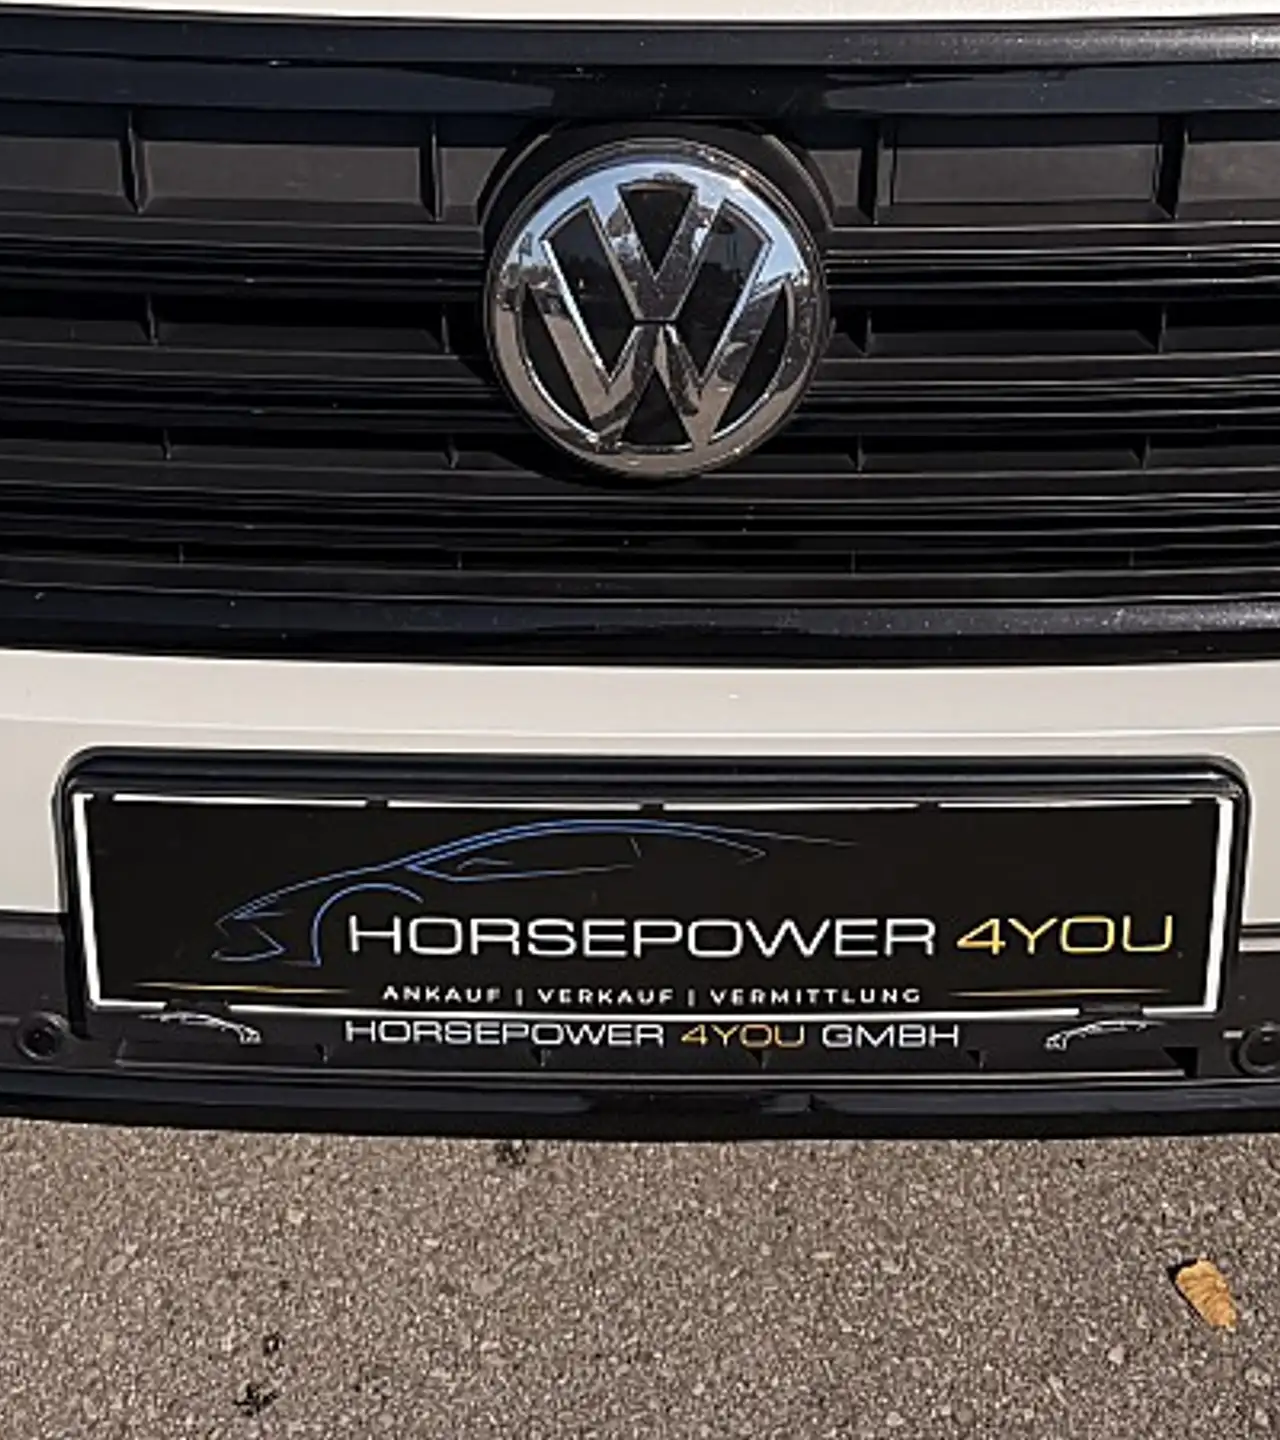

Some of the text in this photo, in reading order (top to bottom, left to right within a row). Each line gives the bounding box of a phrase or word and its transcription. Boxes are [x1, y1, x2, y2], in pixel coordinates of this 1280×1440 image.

[348, 914, 1174, 958] HORSEPOWER 4YOU
[381, 984, 922, 1006] ANKAUF VERKAUF VERMITTLUNG
[344, 1020, 960, 1049] HORSEPOWER 4YOU GMBH
